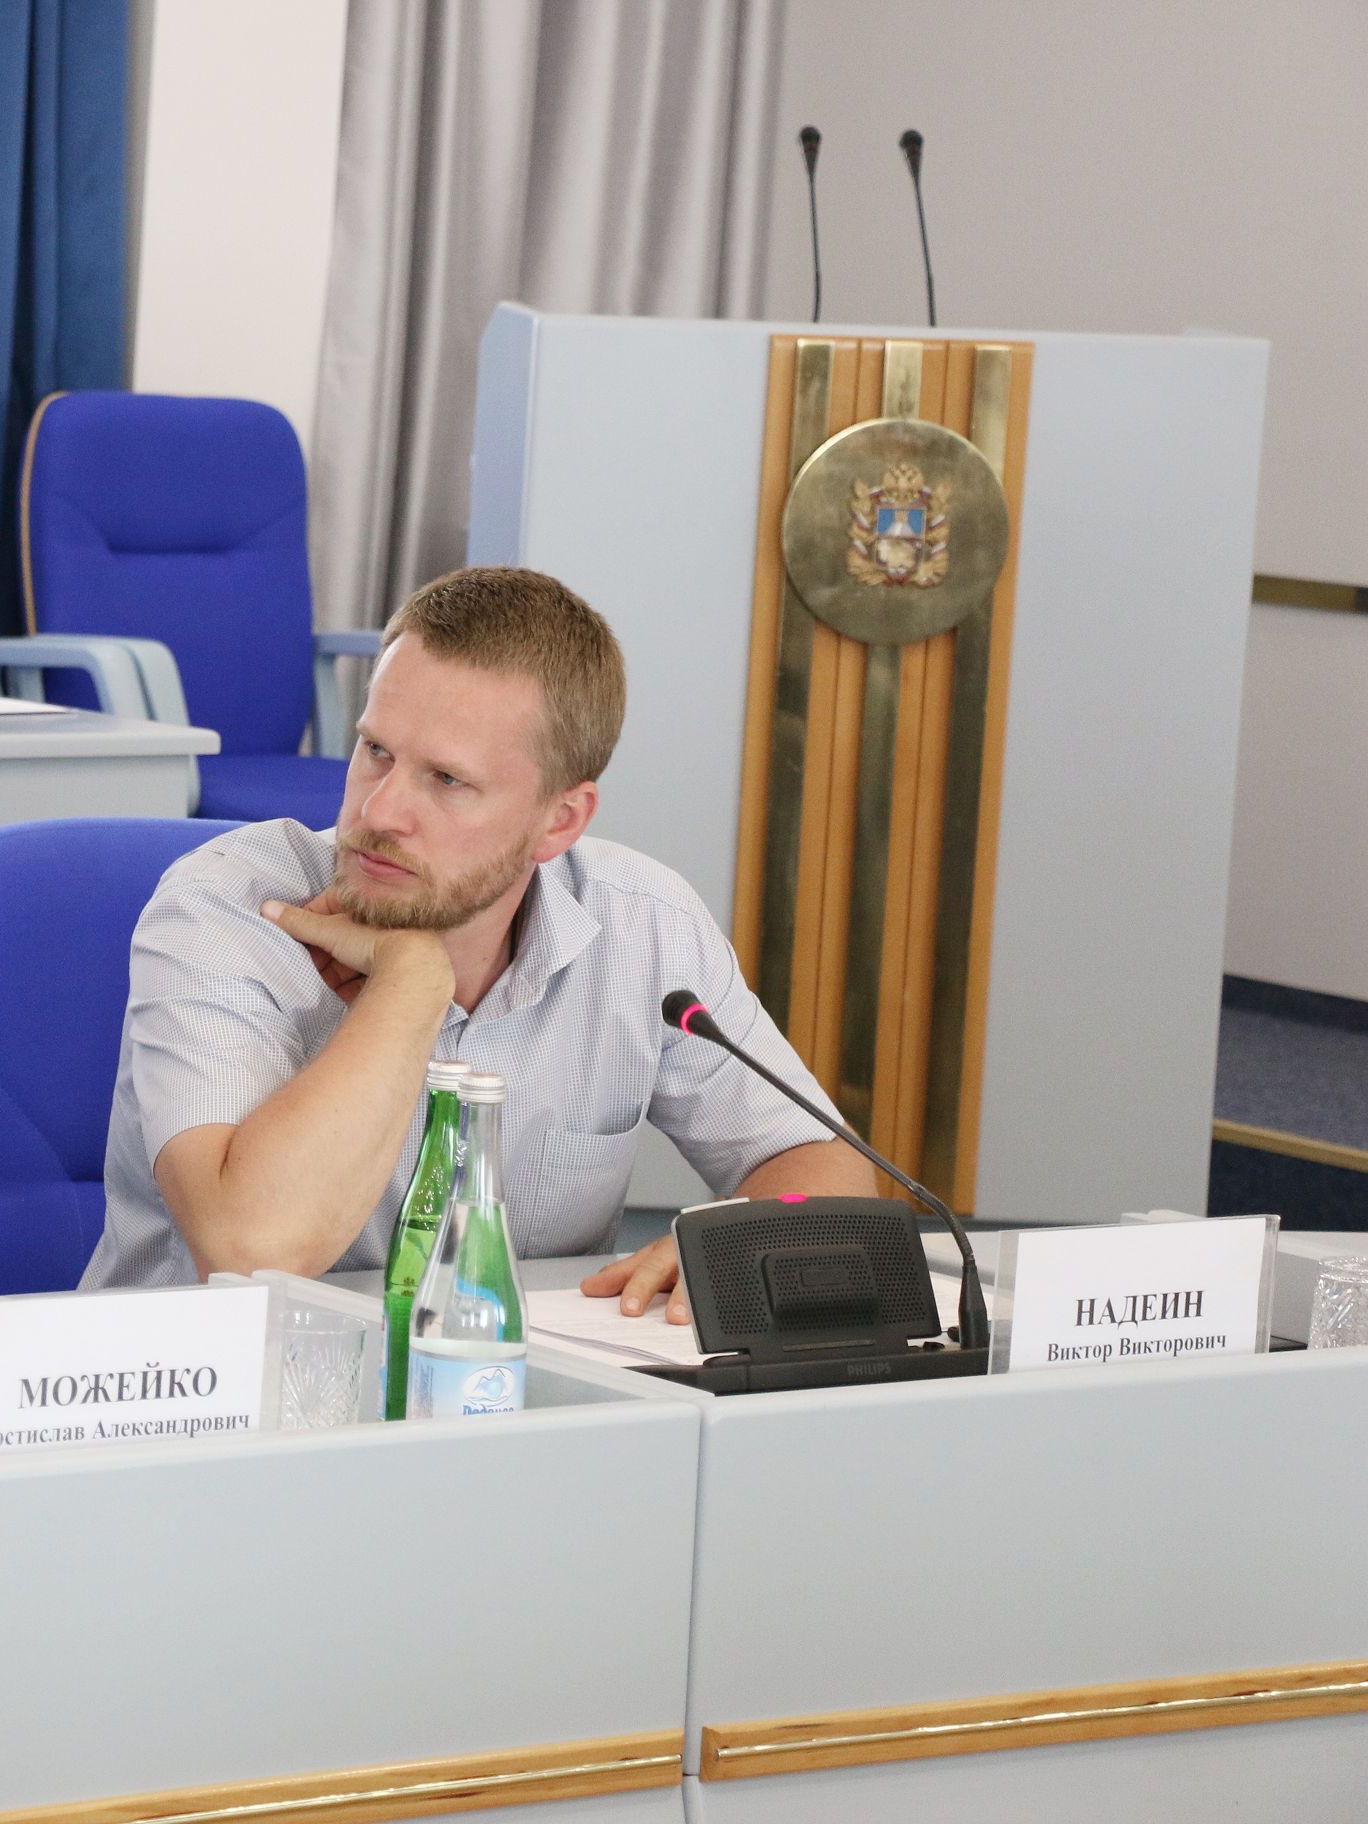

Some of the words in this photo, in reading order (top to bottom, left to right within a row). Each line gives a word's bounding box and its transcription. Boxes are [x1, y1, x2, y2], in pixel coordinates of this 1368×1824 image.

[1075, 1290, 1205, 1329] НАДЕИН
[1047, 1343, 1113, 1362] Виктор
[1119, 1335, 1227, 1357] Викторович
[847, 1361, 892, 1376] PHILIPS
[17, 1361, 218, 1409] МОЖЕЙКО
[92, 1413, 251, 1439] Александрович
